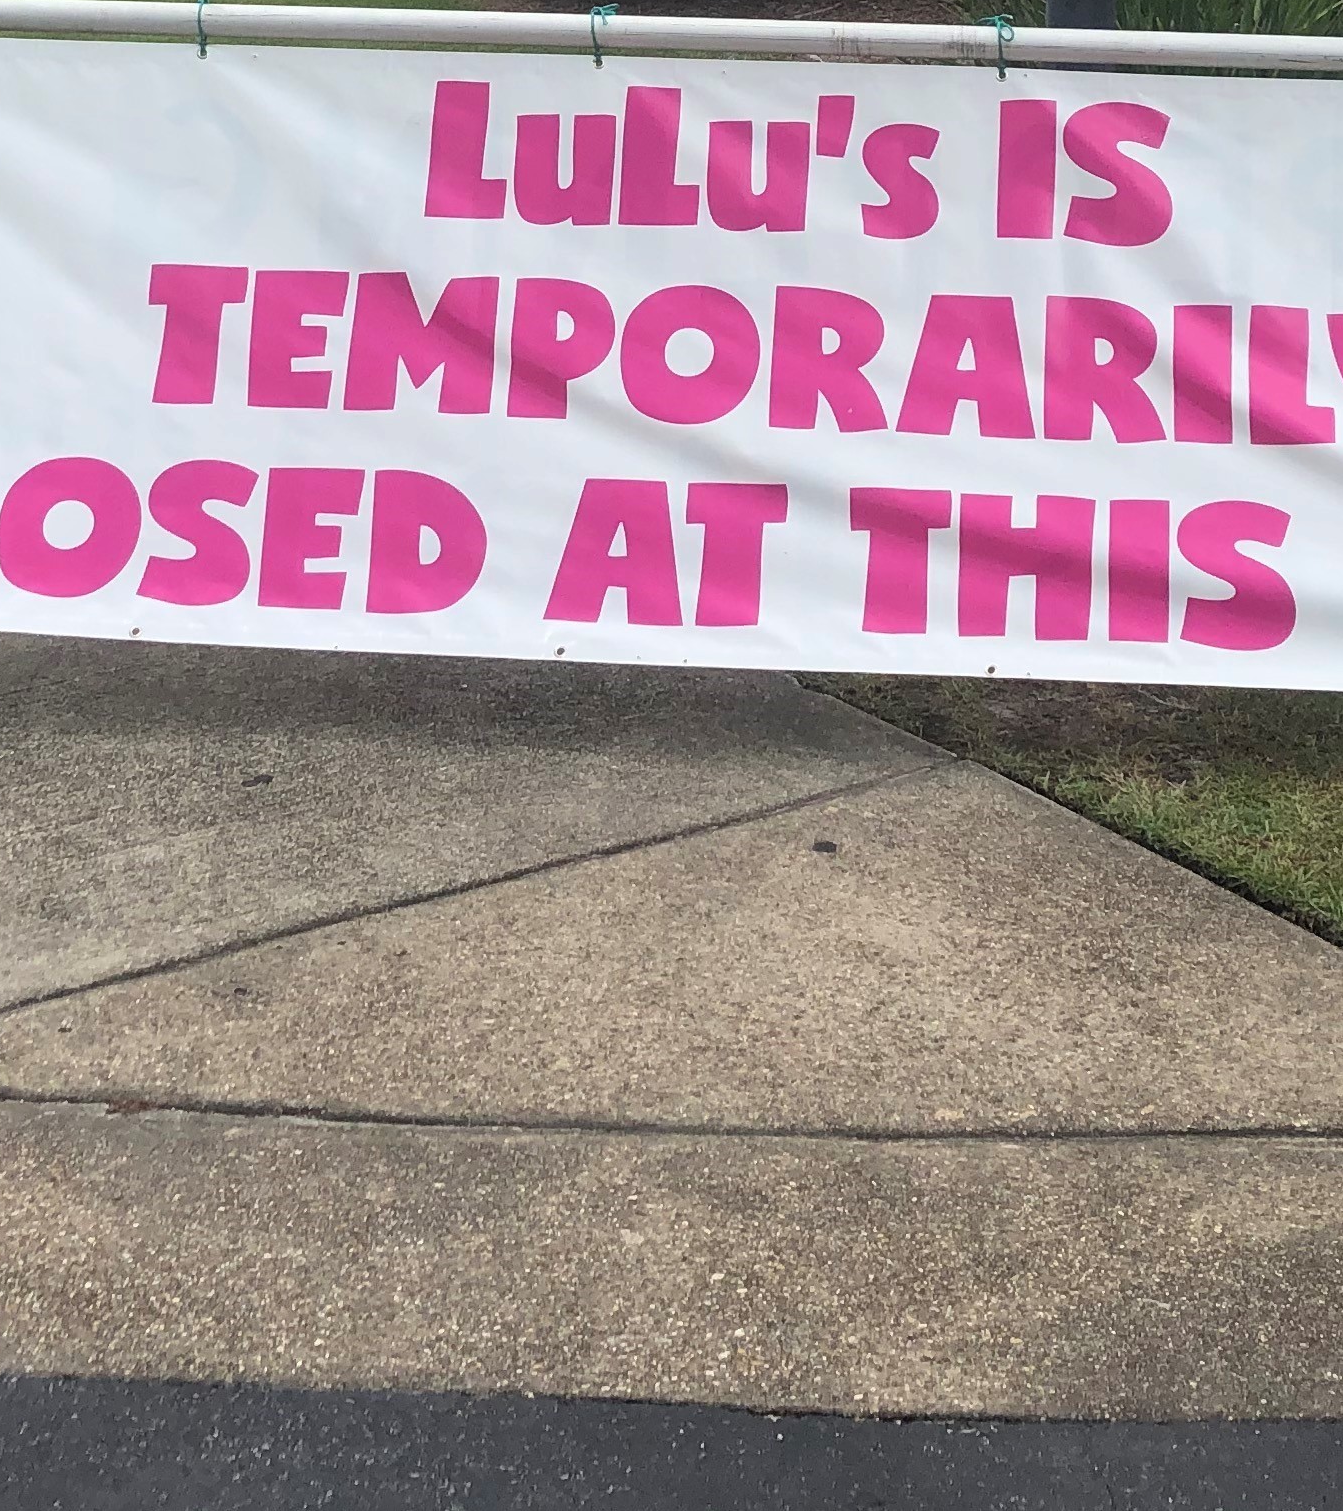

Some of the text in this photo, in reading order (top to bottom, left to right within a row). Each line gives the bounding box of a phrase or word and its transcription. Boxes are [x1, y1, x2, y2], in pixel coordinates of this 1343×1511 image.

[425, 81, 1172, 246] LuLu's IS
[545, 479, 787, 627] AT
[850, 487, 1295, 651] THIS
